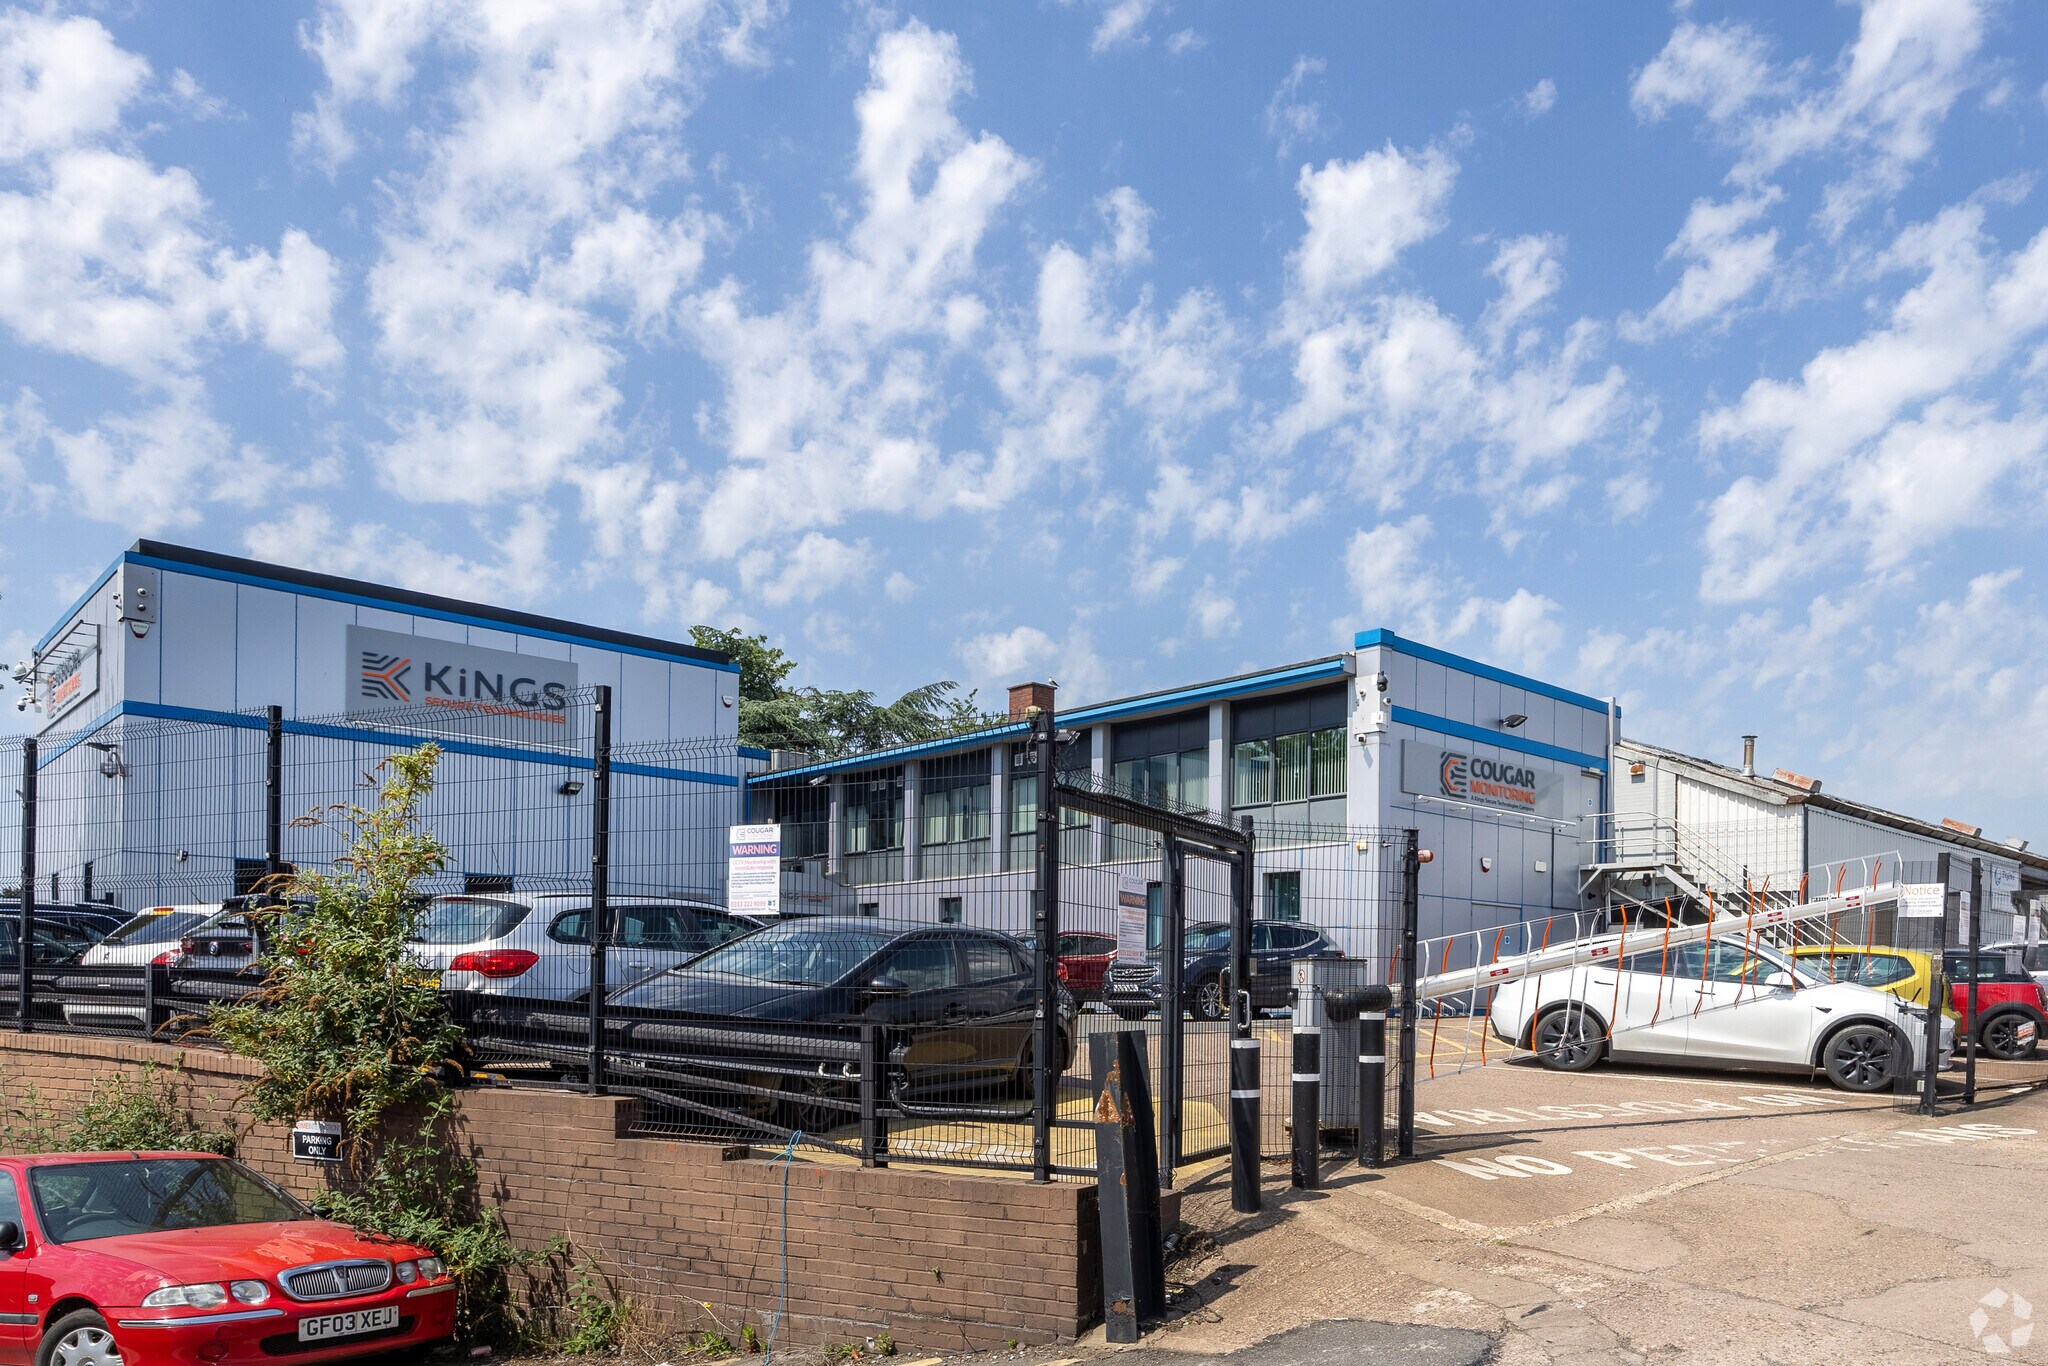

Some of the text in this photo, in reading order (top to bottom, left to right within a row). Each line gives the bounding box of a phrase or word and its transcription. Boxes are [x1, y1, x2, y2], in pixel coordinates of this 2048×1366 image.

[1470, 758, 1536, 789] COUGAR
[1469, 779, 1536, 805] MONITORING
[1497, 800, 1519, 809] Technologies
[1519, 804, 1535, 812] Company
[732, 844, 777, 855] WARNING
[1904, 885, 1939, 895] Notice
[1120, 892, 1146, 906] WARNING
[1738, 1093, 1846, 1106] NO
[302, 1134, 332, 1145] PARKING
[308, 1146, 326, 1155] ONLY
[1431, 1154, 1573, 1180] NO
[307, 1308, 392, 1336] GF03 XEJ
